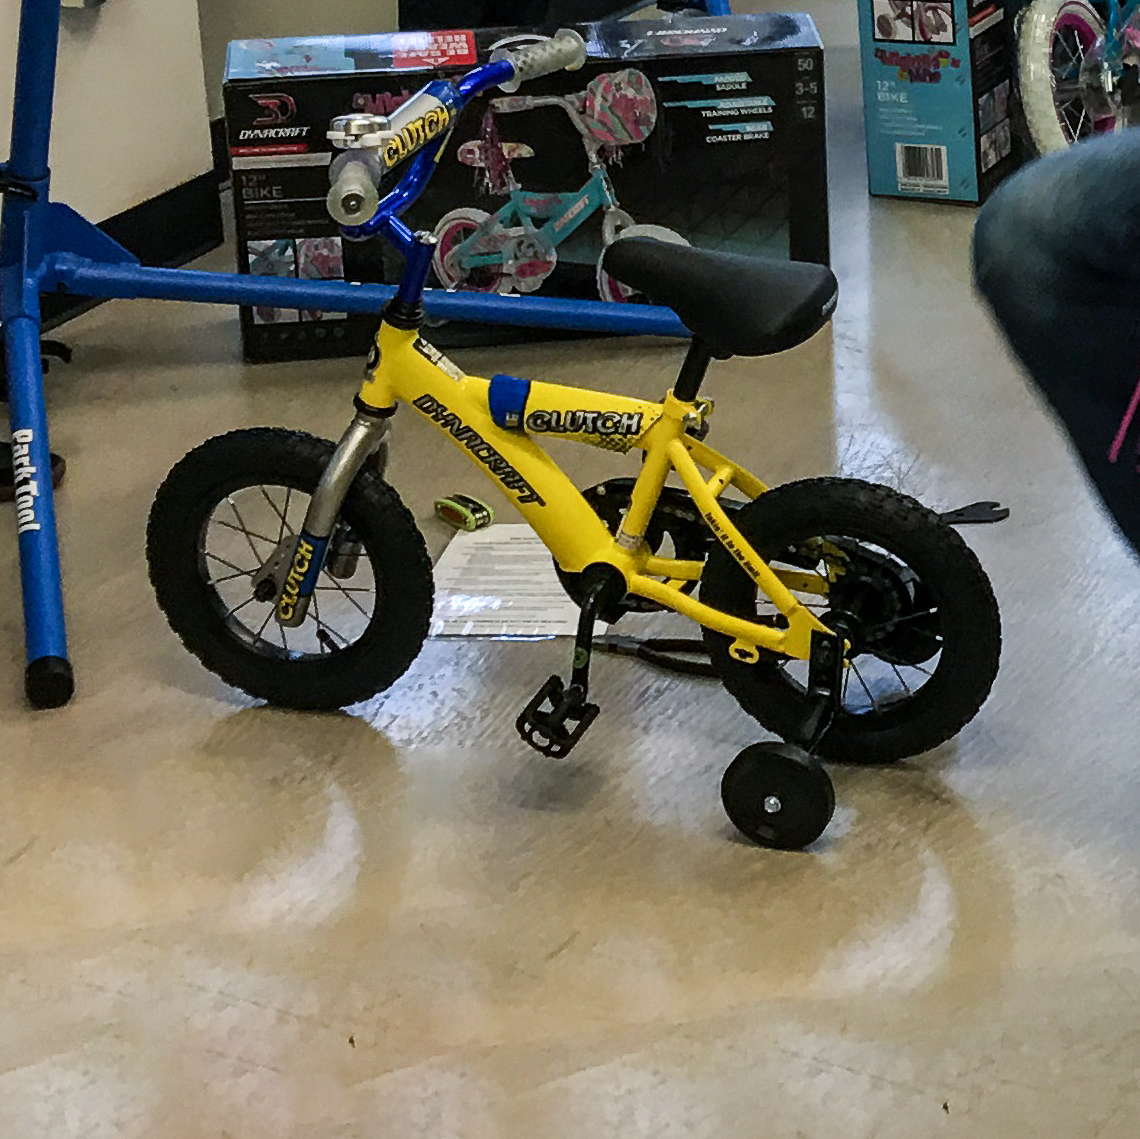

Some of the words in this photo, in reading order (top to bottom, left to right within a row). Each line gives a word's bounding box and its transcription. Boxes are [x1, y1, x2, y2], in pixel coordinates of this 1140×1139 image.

[798, 58, 814, 71] 50
[795, 82, 818, 95] 3-5
[802, 106, 816, 119] 12
[239, 126, 311, 140] DYNACRAFT
[383, 106, 450, 167] CLUTCH
[242, 186, 283, 200] BIKE
[526, 410, 643, 435] CLUTCH
[412, 393, 546, 507] DYNACRAFT
[279, 538, 314, 620] CLUTCH
